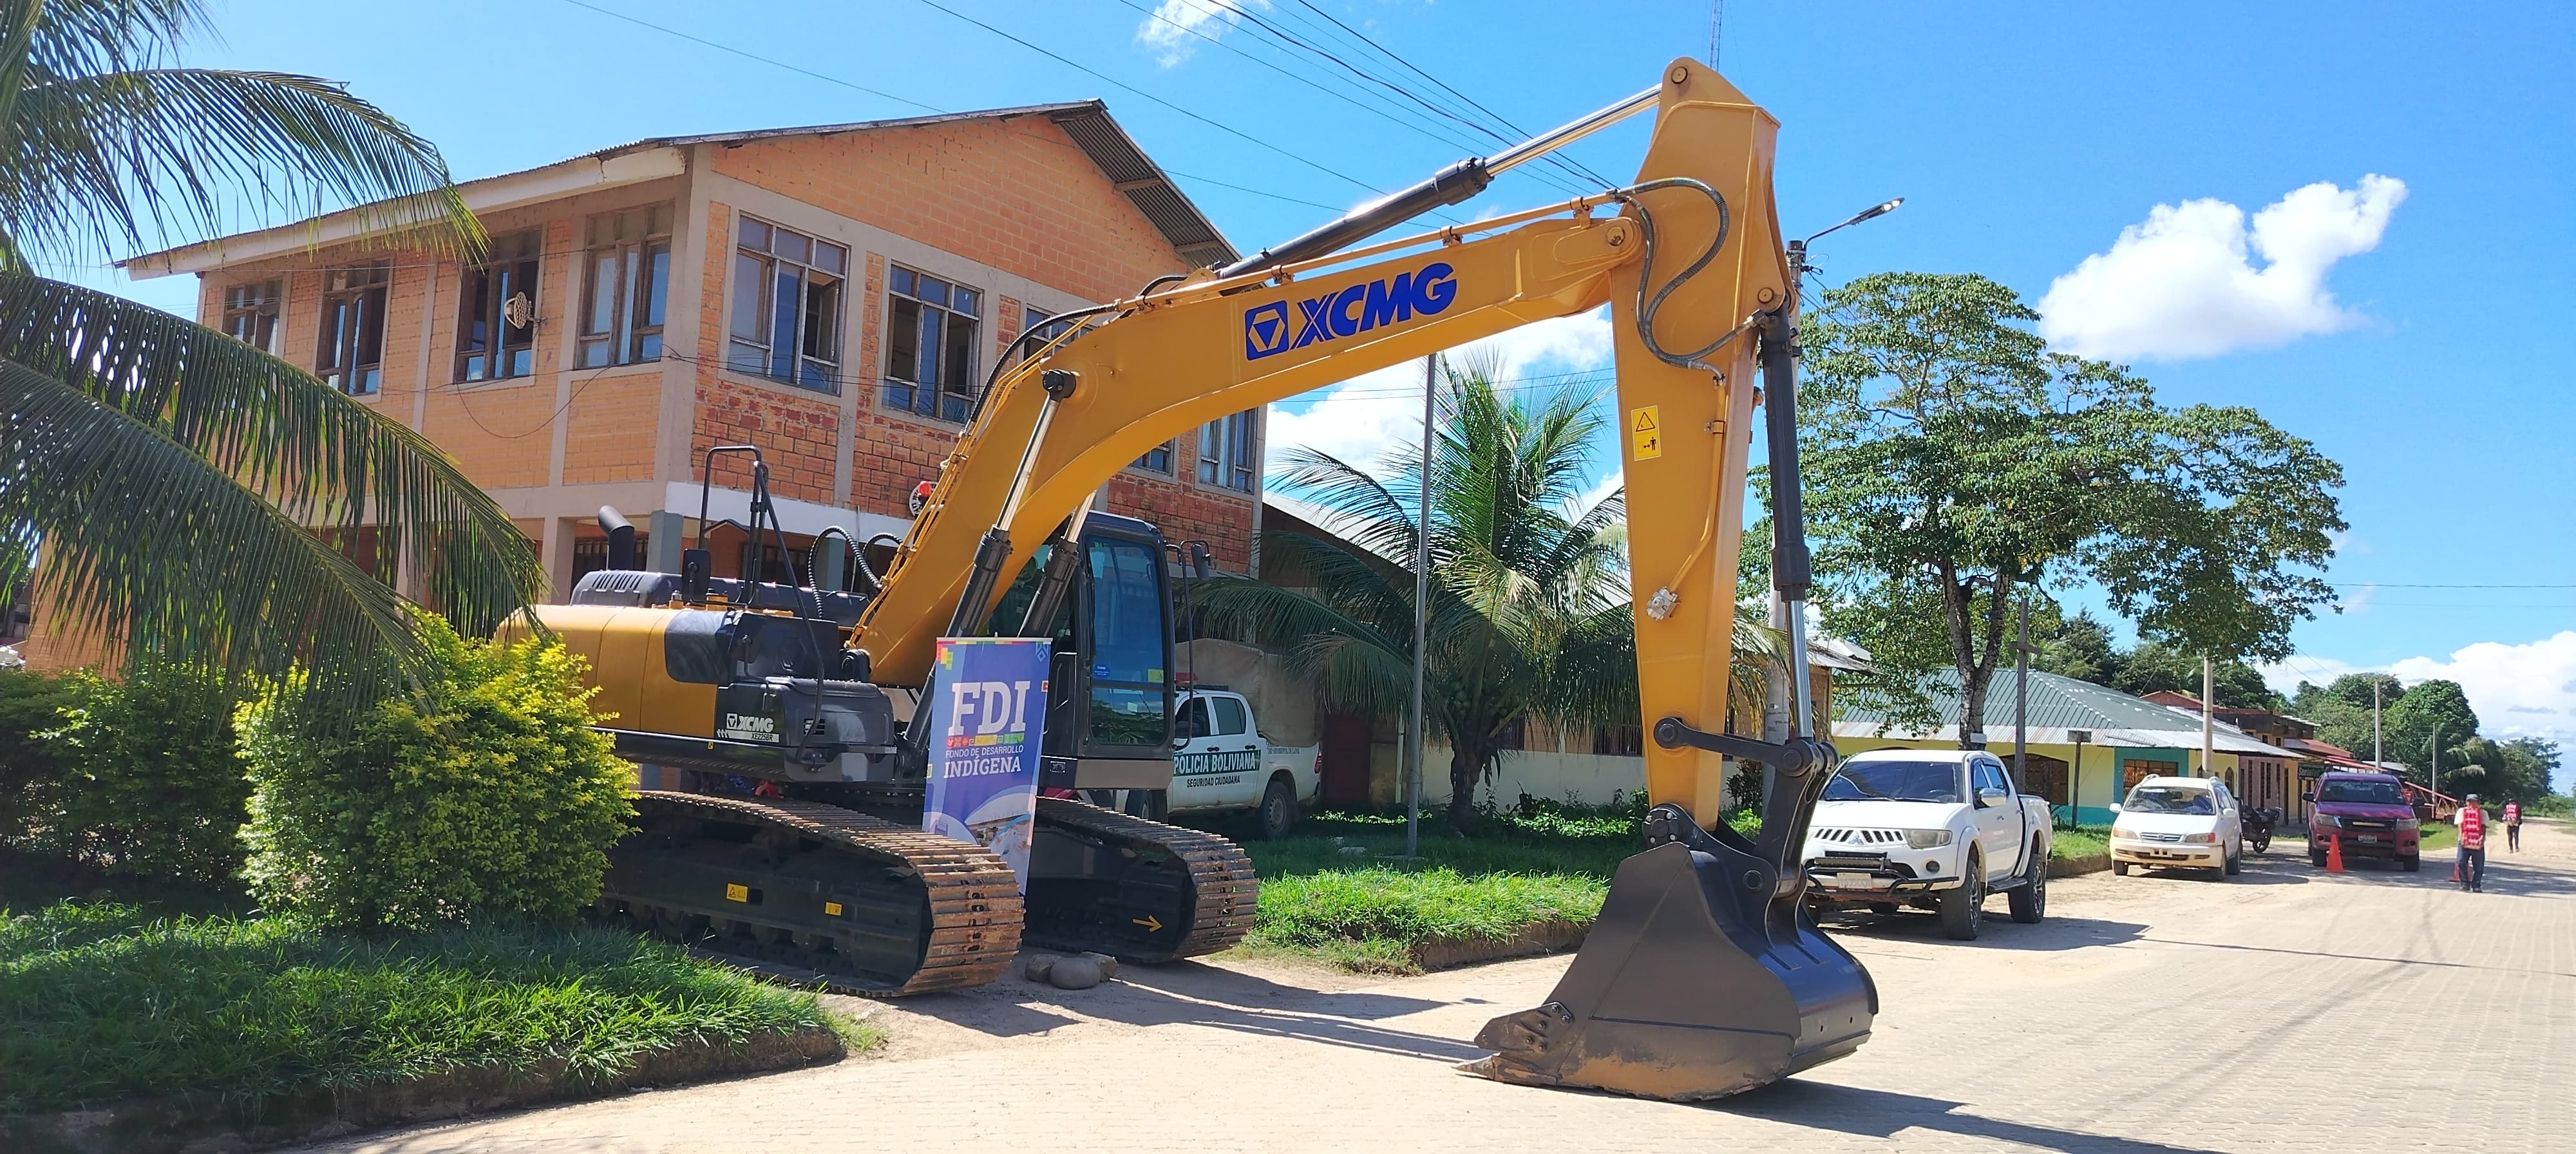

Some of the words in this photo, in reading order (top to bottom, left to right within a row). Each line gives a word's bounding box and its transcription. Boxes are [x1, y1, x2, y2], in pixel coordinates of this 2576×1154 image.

[1290, 263, 1457, 350] XCMG
[948, 681, 1030, 736] FDI
[738, 715, 774, 733] XCMG
[945, 749, 969, 758] FONDO
[971, 748, 980, 756] DE
[981, 744, 1023, 755] DESARROLLO
[943, 755, 1021, 778] INDÍGENA
[1173, 755, 1209, 774] POLICIA
[1211, 752, 1256, 772] BOLIVIANA
[1186, 778, 1214, 788] SEGURIDAD
[1215, 775, 1240, 786] CIUDADANA
